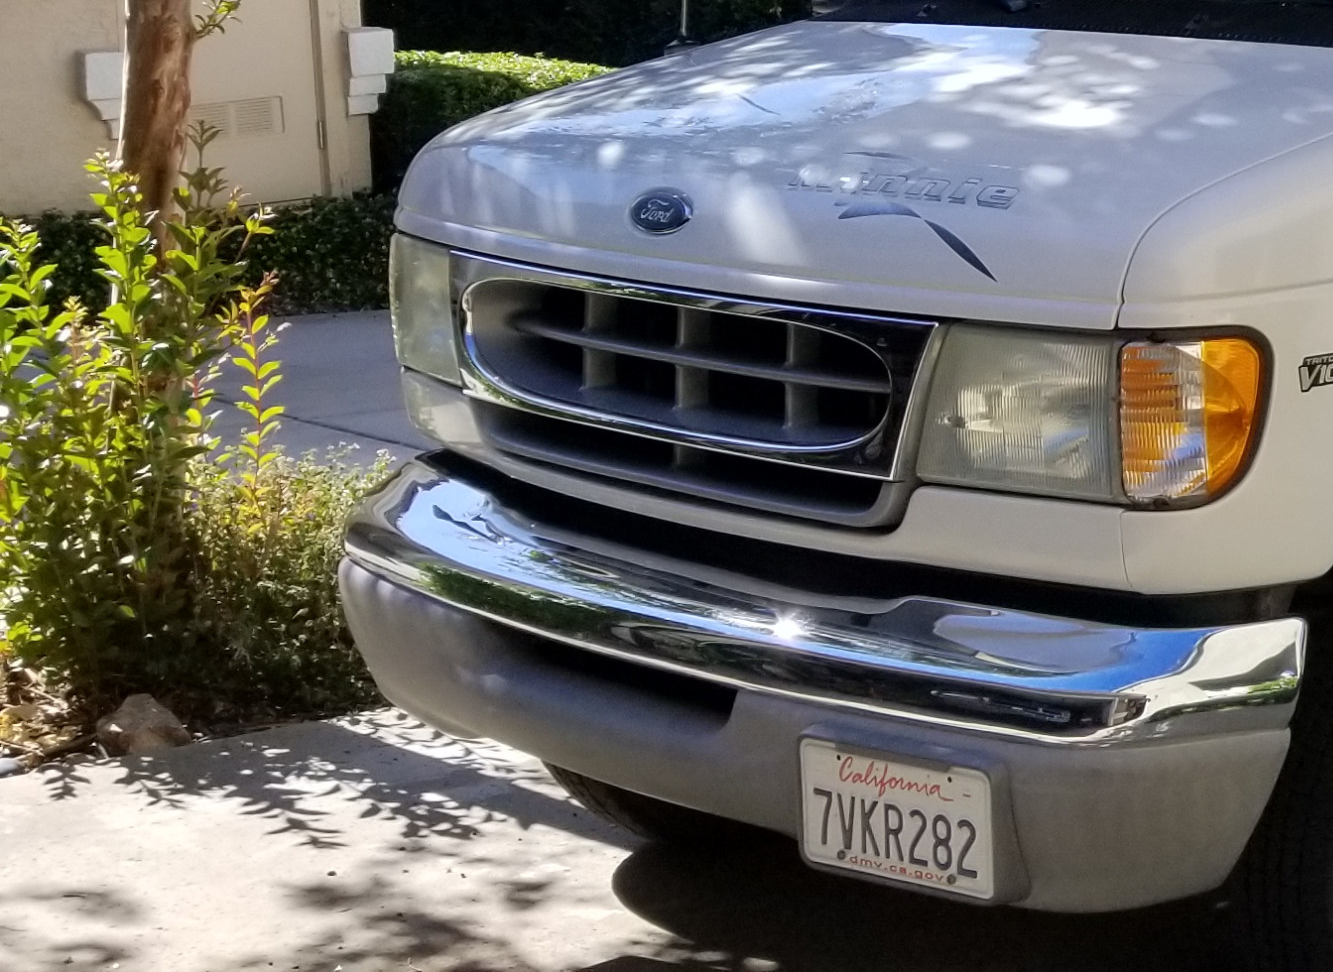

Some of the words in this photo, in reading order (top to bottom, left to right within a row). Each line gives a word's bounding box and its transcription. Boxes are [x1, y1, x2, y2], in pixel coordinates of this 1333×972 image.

[640, 199, 674, 223] Ford
[838, 756, 954, 802] California
[813, 787, 978, 879] 7VKR282
[849, 855, 944, 883] dmv.ca.gov
